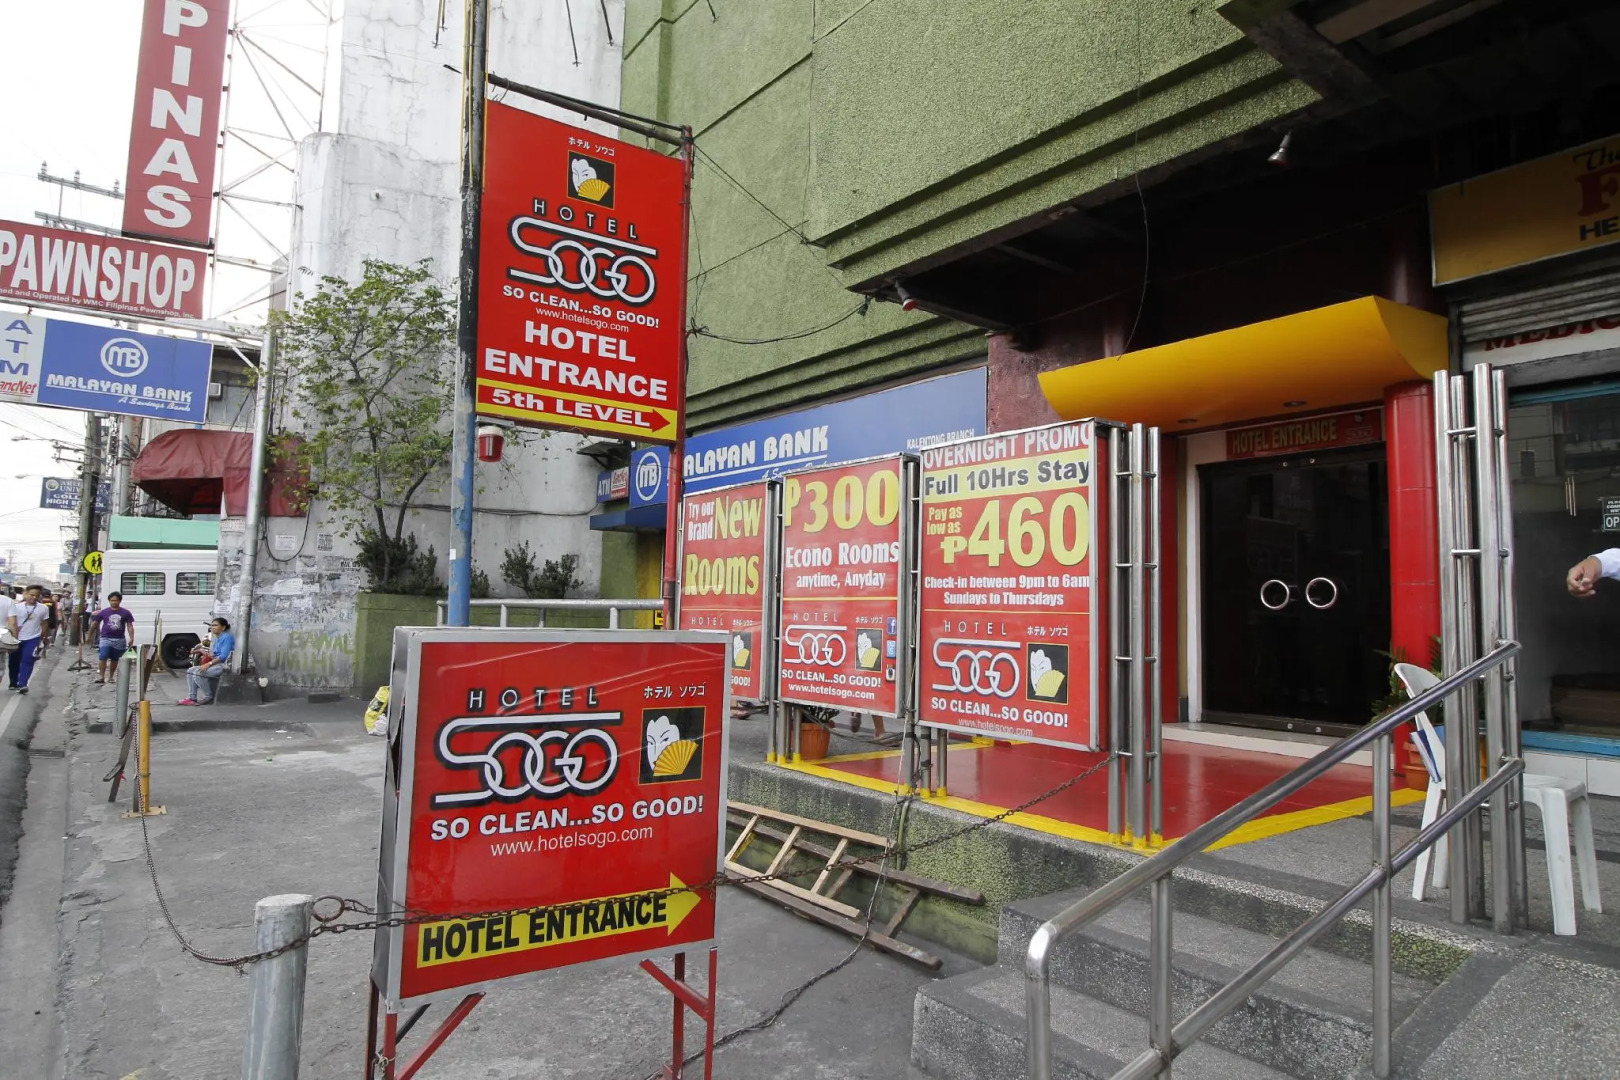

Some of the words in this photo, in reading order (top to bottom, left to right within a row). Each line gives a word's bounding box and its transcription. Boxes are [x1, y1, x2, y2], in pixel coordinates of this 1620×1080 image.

[568, 136, 590, 150] ホテル
[534, 199, 637, 239] HOTEL
[0, 229, 196, 310] PAWNSHOP
[510, 216, 657, 303] SOGO
[15, 289, 31, 297] and
[32, 292, 70, 303] Operated
[71, 297, 81, 305] by
[83, 298, 104, 307] WMC
[105, 301, 138, 312] Filipinas
[140, 306, 181, 318] Pawnshop,
[502, 284, 525, 299] SO
[616, 310, 660, 329] GOOD!
[535, 307, 630, 333] www.hotelsogo.com
[525, 320, 636, 363] HOTEL
[48, 373, 138, 396] MALAYAN
[142, 386, 193, 403] BANK
[485, 347, 668, 401] ENTRANCE
[129, 398, 165, 410] Savings
[166, 401, 191, 411] Bank
[491, 388, 544, 411] 5th
[555, 398, 651, 427] LEVEL
[946, 428, 975, 442] BRANCH
[1232, 429, 1269, 454] HOTEL
[1271, 418, 1337, 448] ENTRANCE
[684, 439, 756, 476] ALAYAN
[763, 425, 829, 462] BANK
[924, 435, 1018, 469] OVERNIGHT
[925, 474, 959, 496] Full
[966, 467, 1029, 491] 10Hrs
[1037, 459, 1089, 484] Stay
[688, 502, 700, 520] Try
[701, 501, 715, 516] our
[714, 495, 763, 540] New
[928, 507, 947, 522] Pay
[948, 506, 963, 519] as
[687, 517, 713, 541] Brand
[927, 521, 947, 535] low
[947, 521, 961, 534] as
[785, 546, 832, 568] Econo
[838, 541, 899, 566] Rooms
[684, 553, 760, 596] Rooms
[796, 572, 841, 589] anytime,
[844, 570, 886, 590] Anyday
[924, 576, 967, 589] Check-in
[970, 575, 1016, 588] between
[1019, 575, 1045, 590] 9pm
[1047, 576, 1060, 588] to
[1062, 574, 1090, 588] 6am
[944, 592, 988, 606] Sundays
[989, 592, 1000, 605] to
[1002, 592, 1064, 607] Thursdays
[691, 617, 724, 626] HOTEL
[793, 612, 838, 622] HOTEL
[944, 621, 1006, 635] HOTEL
[784, 624, 848, 667] SOGO
[781, 669, 794, 679] SO
[849, 675, 881, 688] GOOD!
[932, 637, 1021, 698] SOGO
[469, 687, 597, 709] HOTEL
[644, 684, 673, 699] ホテル
[788, 683, 875, 700] www.hotelsogo.com
[931, 697, 947, 710] SO
[1023, 708, 1068, 728] GOOD!
[435, 711, 621, 803] SOGO
[430, 818, 470, 842] SO
[632, 795, 704, 820] GOOD!
[490, 824, 654, 857] www.hotelsogo.com
[422, 914, 520, 962] HOTEL
[528, 895, 667, 944] ENTRANCE
